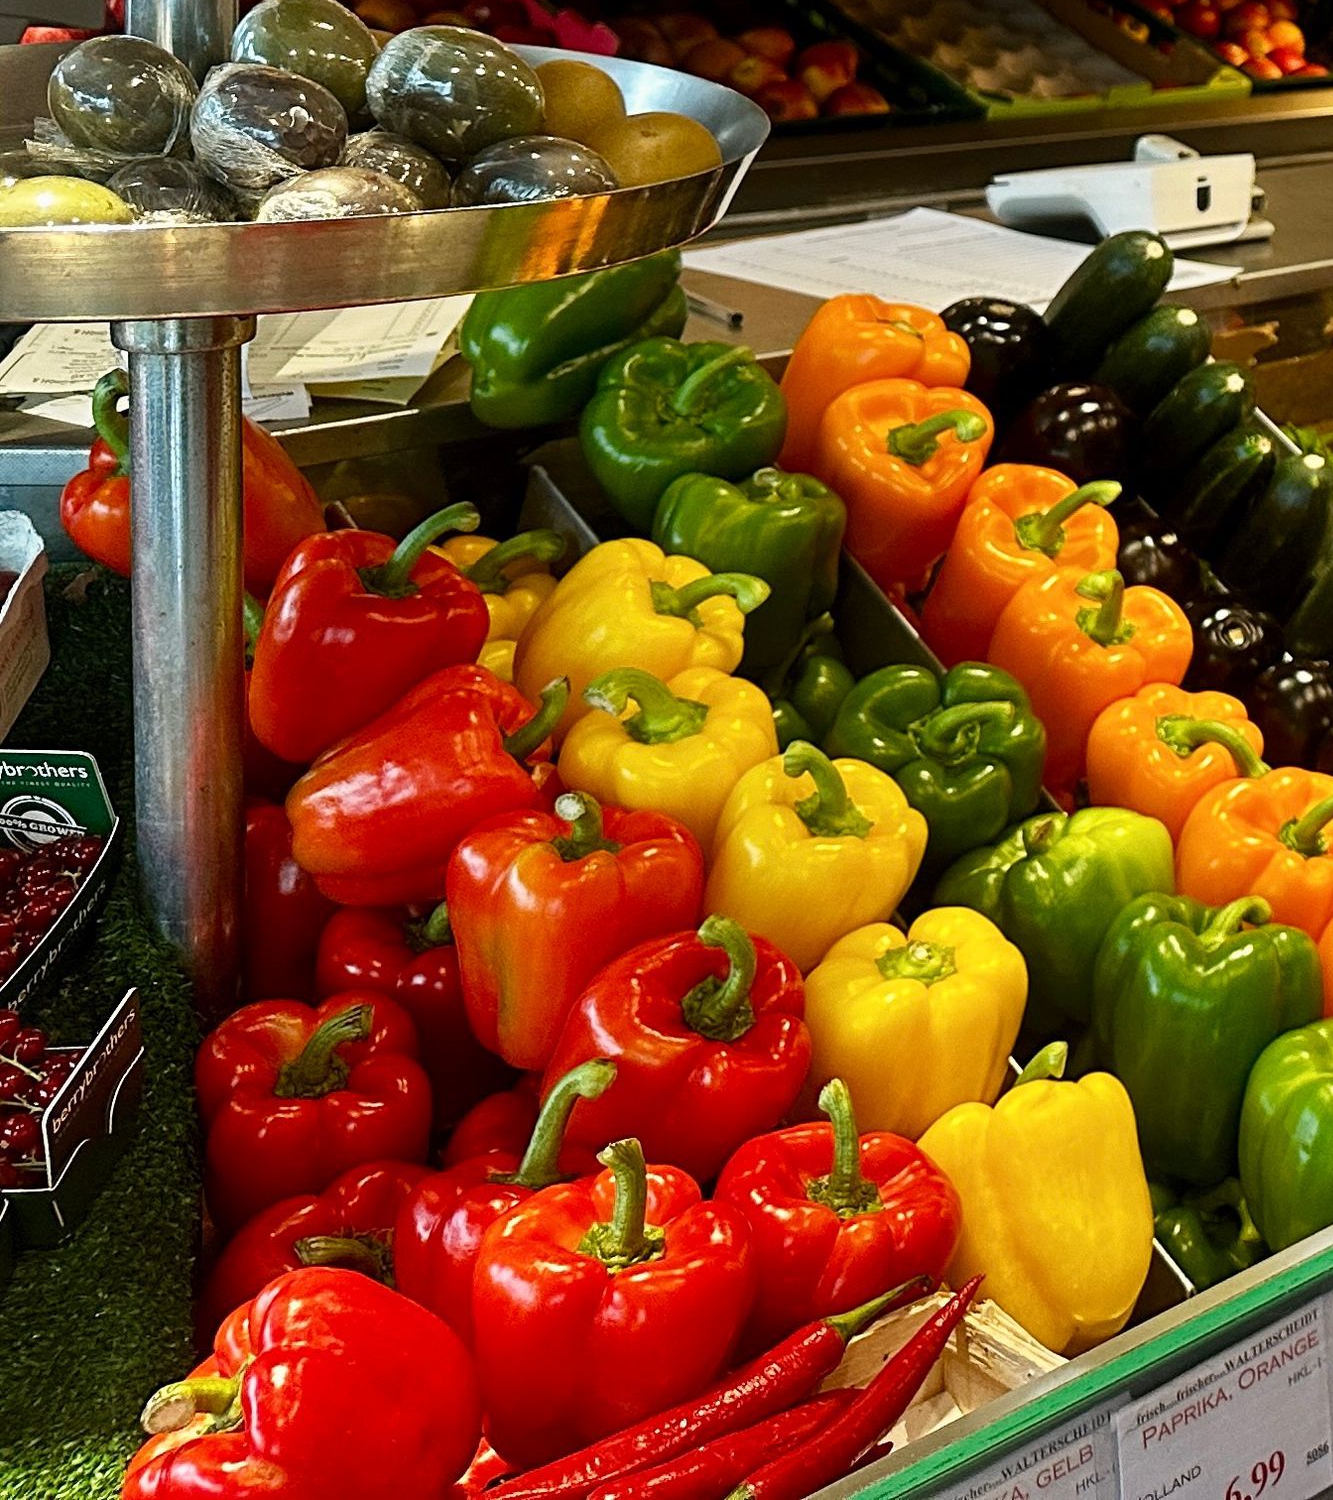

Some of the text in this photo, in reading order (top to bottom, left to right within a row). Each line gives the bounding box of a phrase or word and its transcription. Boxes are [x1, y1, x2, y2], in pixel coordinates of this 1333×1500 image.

[52, 1008, 136, 1135] berrybrothers
[1141, 1330, 1320, 1450] PAPRIKA, ORANGE
[1036, 1443, 1094, 1490] GELB
